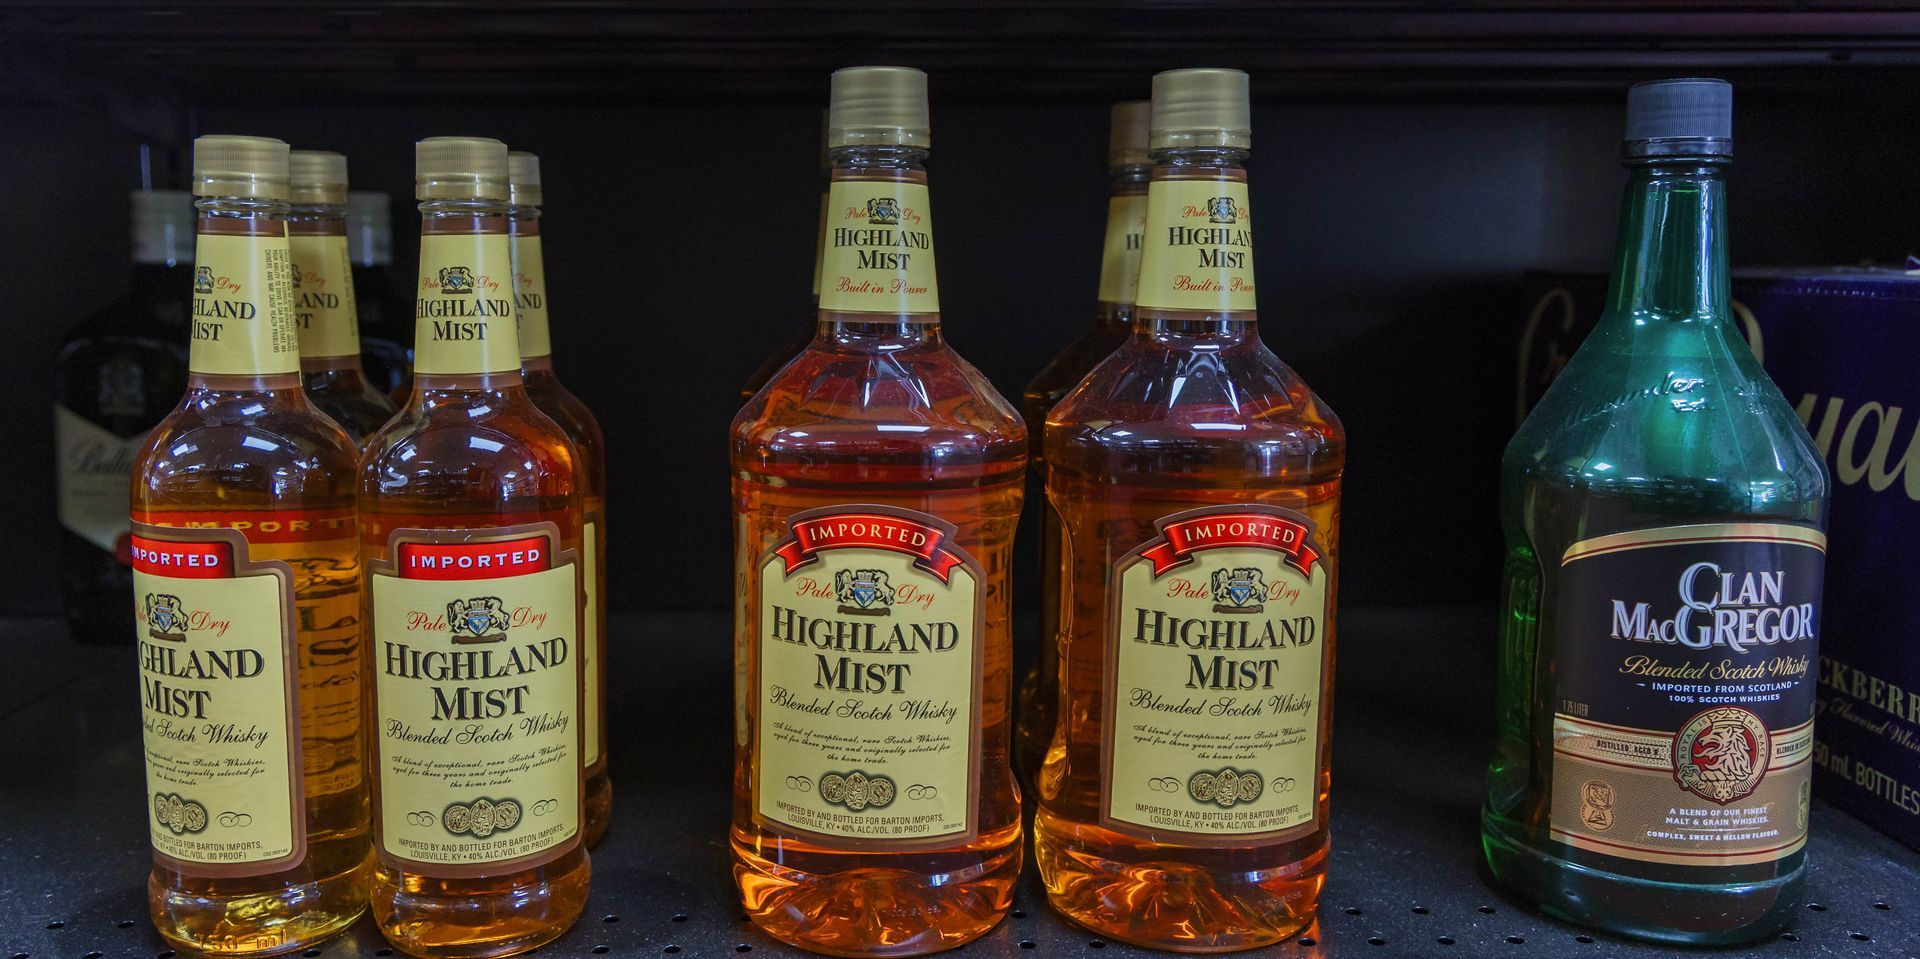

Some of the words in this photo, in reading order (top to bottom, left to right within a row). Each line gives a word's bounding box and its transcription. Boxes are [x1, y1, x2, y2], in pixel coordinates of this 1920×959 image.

[845, 207, 866, 219] Pale
[903, 208, 921, 225] Dry
[1182, 206, 1207, 218] Pale
[834, 228, 929, 249] HIGHLAND
[1168, 226, 1252, 248] HIGHLAN
[857, 250, 911, 270] MIST
[1198, 248, 1245, 268] MIST
[216, 276, 241, 294] Dry
[422, 277, 439, 289] Pale
[476, 276, 500, 293] Dry
[836, 276, 870, 293] Built
[872, 283, 884, 293] in
[1173, 275, 1211, 291] Built
[1212, 281, 1224, 291] in
[417, 299, 510, 318] HIGHLAND
[433, 321, 488, 340] MIST
[810, 523, 927, 547] IMPORTED
[1185, 522, 1295, 543] IMPORTED
[410, 549, 540, 569] IMPORTED
[796, 577, 833, 599] Pale
[897, 583, 935, 610] Dry
[1166, 578, 1208, 599] Pale
[1269, 580, 1300, 606] Dry
[1678, 562, 1785, 611] CLAN
[191, 610, 230, 637] Dry
[407, 611, 447, 631] Pale
[510, 607, 548, 630] Dry
[771, 605, 959, 653] HIGHLAND
[1134, 607, 1315, 651] HIGHLAND
[384, 637, 568, 681] HIGHLAND
[1619, 655, 1709, 679] Blended
[1710, 659, 1765, 679] Scotch
[1768, 654, 1809, 679] Whisky
[814, 653, 912, 693] MIST
[1185, 654, 1279, 691] MIST
[1652, 682, 1711, 693] IMPORTED
[1715, 685, 1744, 693] FROM
[1748, 681, 1791, 692] SCOTLAND
[144, 675, 212, 720] MIST
[430, 685, 530, 721] MIST
[769, 685, 834, 716] Blended
[836, 699, 893, 720] Scotch
[899, 700, 958, 724] Whisky
[1129, 687, 1205, 716] Blended
[1209, 697, 1264, 717] Scotch
[1268, 693, 1312, 716] Whisky
[1669, 695, 1694, 703] 100%
[1739, 693, 1780, 702] WHISKIES
[156, 719, 196, 743] Scotch
[202, 723, 268, 748] Whisky
[387, 718, 453, 744] Blended
[456, 723, 514, 744] Scotch
[520, 711, 569, 738] Whisky
[784, 725, 802, 735] blend
[804, 729, 812, 739] of
[813, 730, 859, 743] exceptional,
[884, 736, 913, 744] Scotch
[1748, 720, 1758, 730] MY
[773, 732, 788, 742] aged
[788, 735, 800, 744] for
[801, 739, 820, 747] three
[821, 743, 843, 751] years
[863, 745, 906, 755] originally
[908, 744, 937, 753] selected
[937, 744, 950, 753] for
[1680, 728, 1696, 758] ROYAL
[841, 755, 862, 763] home
[776, 801, 806, 816] IMPORTED
[807, 809, 816, 817] BY
[817, 812, 831, 821] AND
[834, 814, 864, 824] BOTTLED
[882, 816, 910, 825] BARTON
[912, 814, 944, 825] IMPORTS,
[1135, 803, 1171, 817] IMPORTED
[1174, 809, 1183, 817] BY
[1184, 810, 1200, 819] AND
[1203, 812, 1233, 820] BOTTLED
[1235, 812, 1247, 821] FOR
[1250, 810, 1275, 820] BARTON
[1665, 817, 1689, 825] MALT
[1724, 808, 1740, 816] OUR
[1744, 807, 1767, 815] FINEST
[787, 815, 825, 830] LOUISVILLE,
[826, 822, 835, 831] KY
[892, 825, 902, 834] (80
[904, 825, 930, 833] PROOF)
[1150, 815, 1193, 828] LOUISVILLE,
[1194, 820, 1204, 829] KY
[1211, 821, 1225, 829] 40%
[399, 838, 429, 851] IMPORTED
[459, 843, 491, 851] BOTTLED
[509, 834, 536, 846] BARTON
[1647, 831, 1686, 840] COMPLEX,
[184, 841, 195, 849] FOR
[197, 842, 224, 851] BARTON
[219, 852, 246, 860] PROOF)
[410, 851, 450, 860] LOUISVILLE,
[468, 852, 482, 860] 40%
[520, 845, 530, 854] (80
[531, 838, 553, 851] PROOF)
